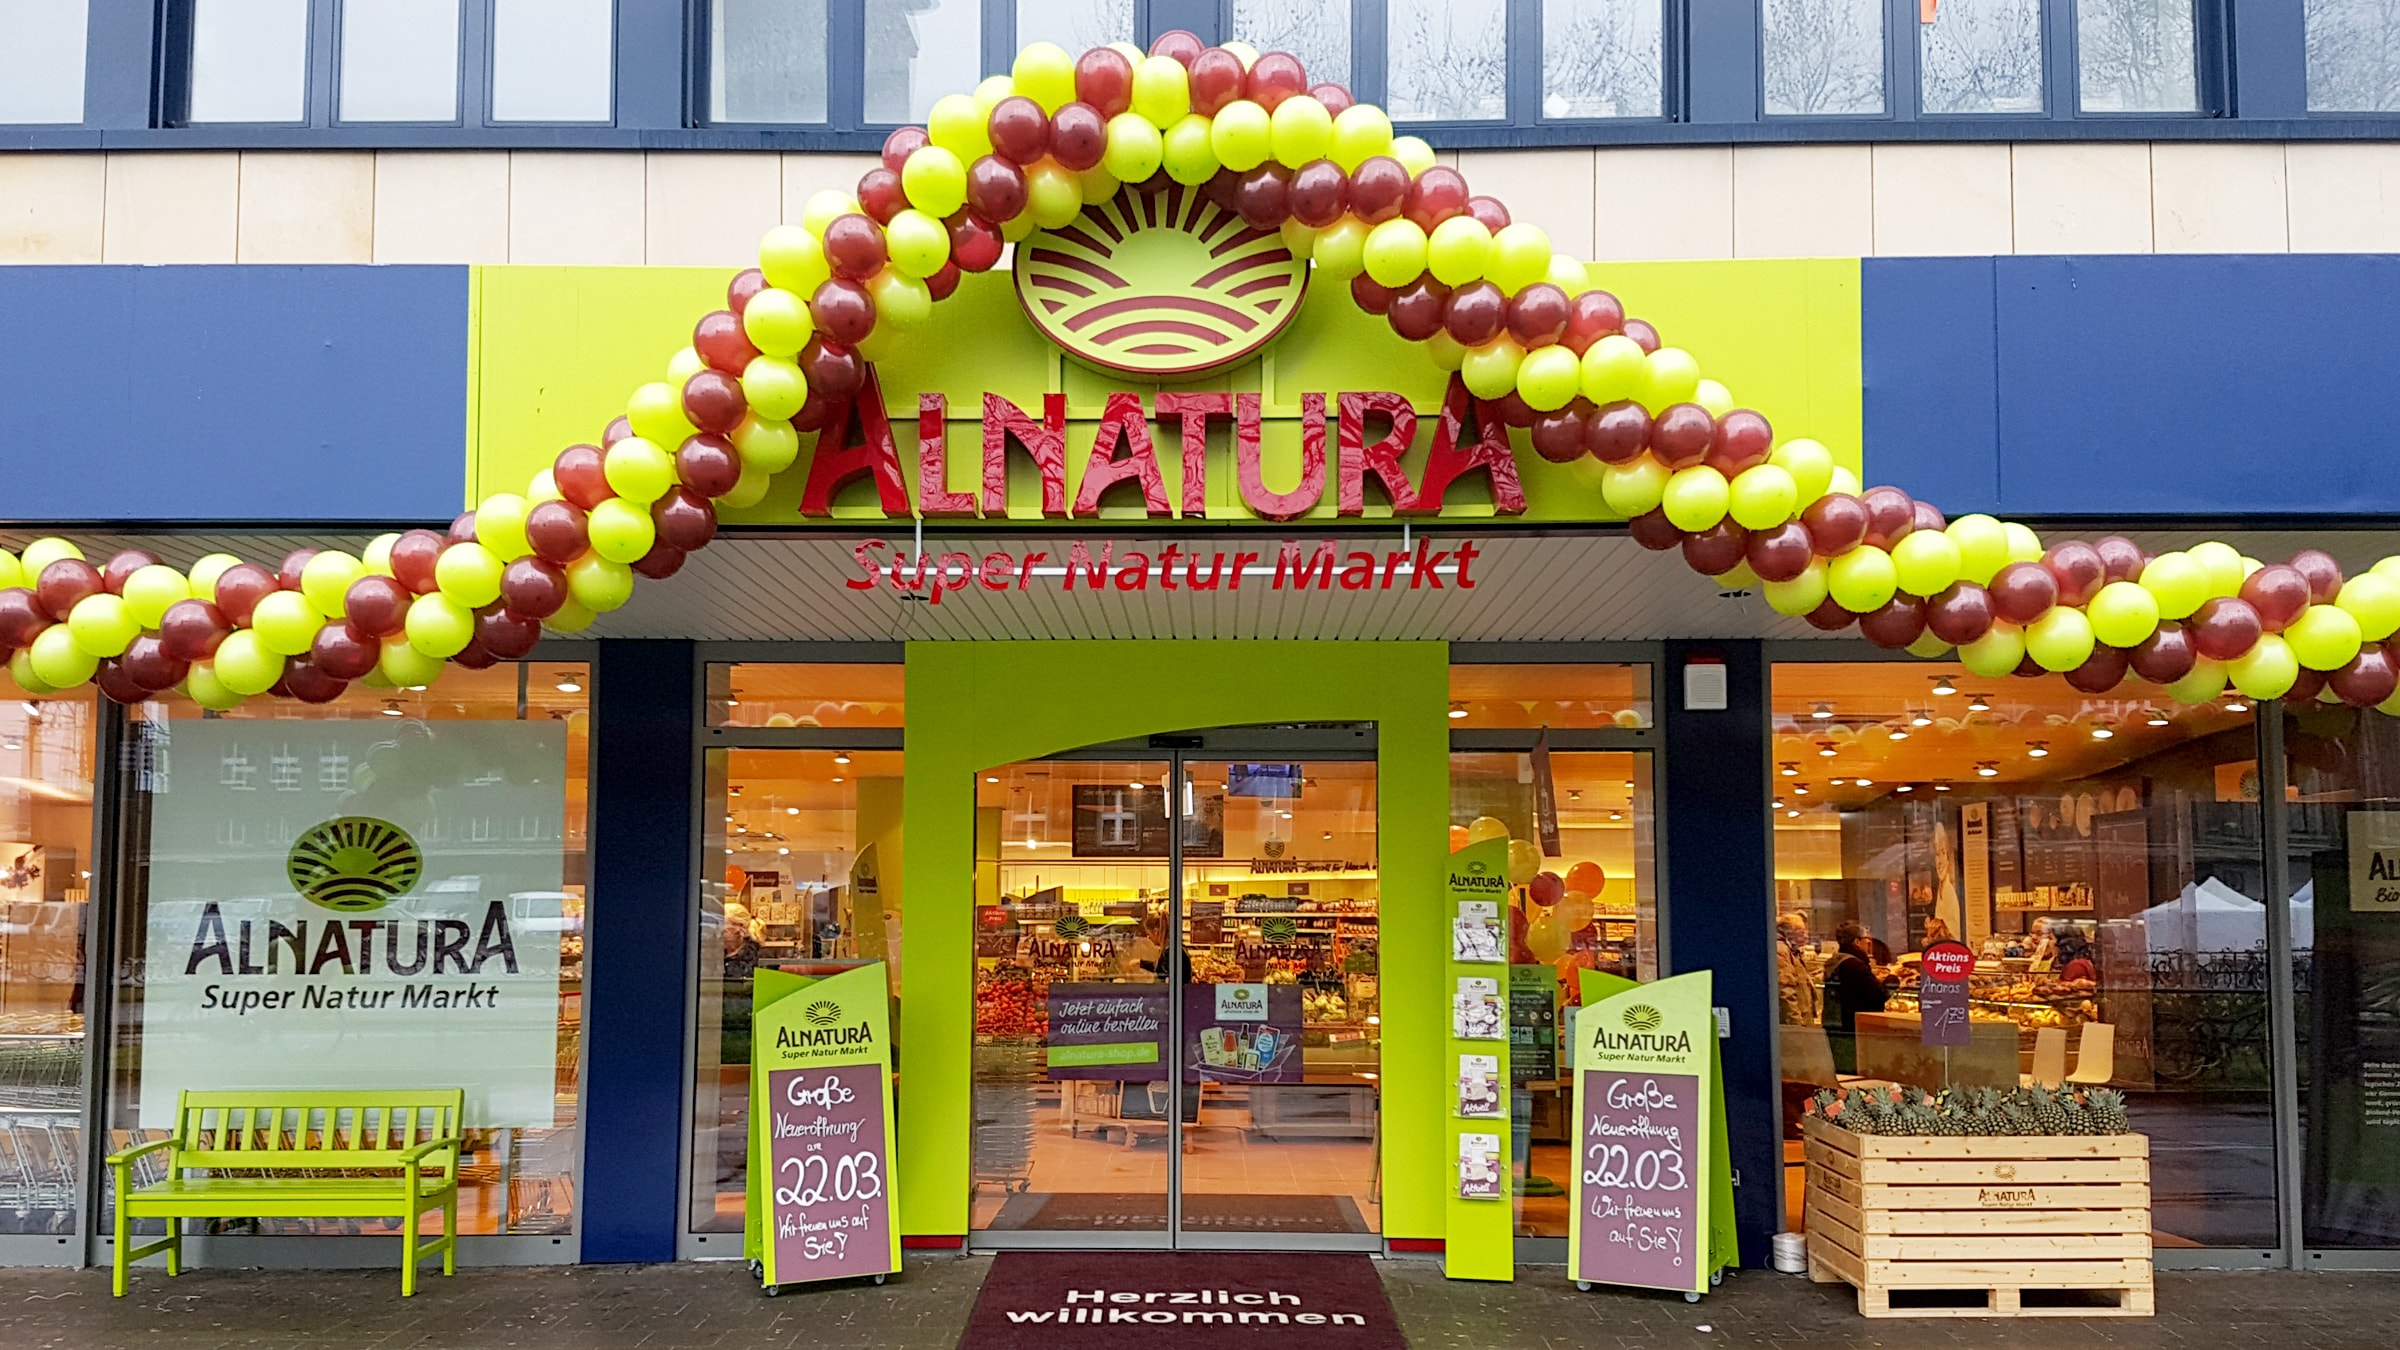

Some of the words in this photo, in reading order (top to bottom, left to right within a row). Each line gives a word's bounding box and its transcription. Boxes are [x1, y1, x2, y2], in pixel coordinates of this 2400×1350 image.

[800, 362, 1528, 521] ALNATURA
[846, 538, 1047, 604] Super
[1063, 540, 1258, 590] Natur
[1272, 536, 1479, 590] Markt
[2369, 852, 2400, 880] AL
[1449, 872, 1504, 888] ALNATURA
[184, 901, 519, 976] ALNATURA
[1029, 938, 1115, 958] ALNATURA
[1086, 960, 1111, 968] Markt
[1928, 952, 1969, 962] Aktions
[1935, 963, 1961, 973] Preis
[1921, 976, 1961, 993] Ananas
[202, 985, 295, 1015] Super
[302, 985, 394, 1009] Natur
[400, 982, 499, 1009] Markt
[1059, 1001, 1096, 1018] Jetzt
[1097, 996, 1144, 1017] einfach
[1221, 999, 1263, 1010] ALNATURA
[776, 1021, 872, 1048] ALNATURA
[1061, 1019, 1101, 1034] online
[1104, 1016, 1159, 1033] bestellen
[782, 1050, 809, 1060] Super
[812, 1048, 838, 1057] Natur
[840, 1046, 868, 1055] Markt
[1593, 1027, 1691, 1053] ALNATURA
[1598, 1051, 1625, 1062] Super
[1627, 1053, 1654, 1062] Natur
[1656, 1055, 1685, 1063] Markt
[788, 1076, 855, 1110] Große
[1607, 1079, 1677, 1113] Große
[776, 1151, 882, 1206] 22.03.
[1583, 1143, 1689, 1190] 22.03.
[1591, 1195, 1622, 1218] Wir
[1624, 1194, 1659, 1220] freuen
[1661, 1206, 1681, 1218] uns
[778, 1213, 797, 1239] Wir
[798, 1212, 828, 1237] freuen
[829, 1216, 849, 1228] uns
[852, 1204, 869, 1230] auf
[1609, 1223, 1636, 1249] auf
[1066, 1290, 1301, 1306] Herzlich
[1006, 1308, 1366, 1326] willkommen
